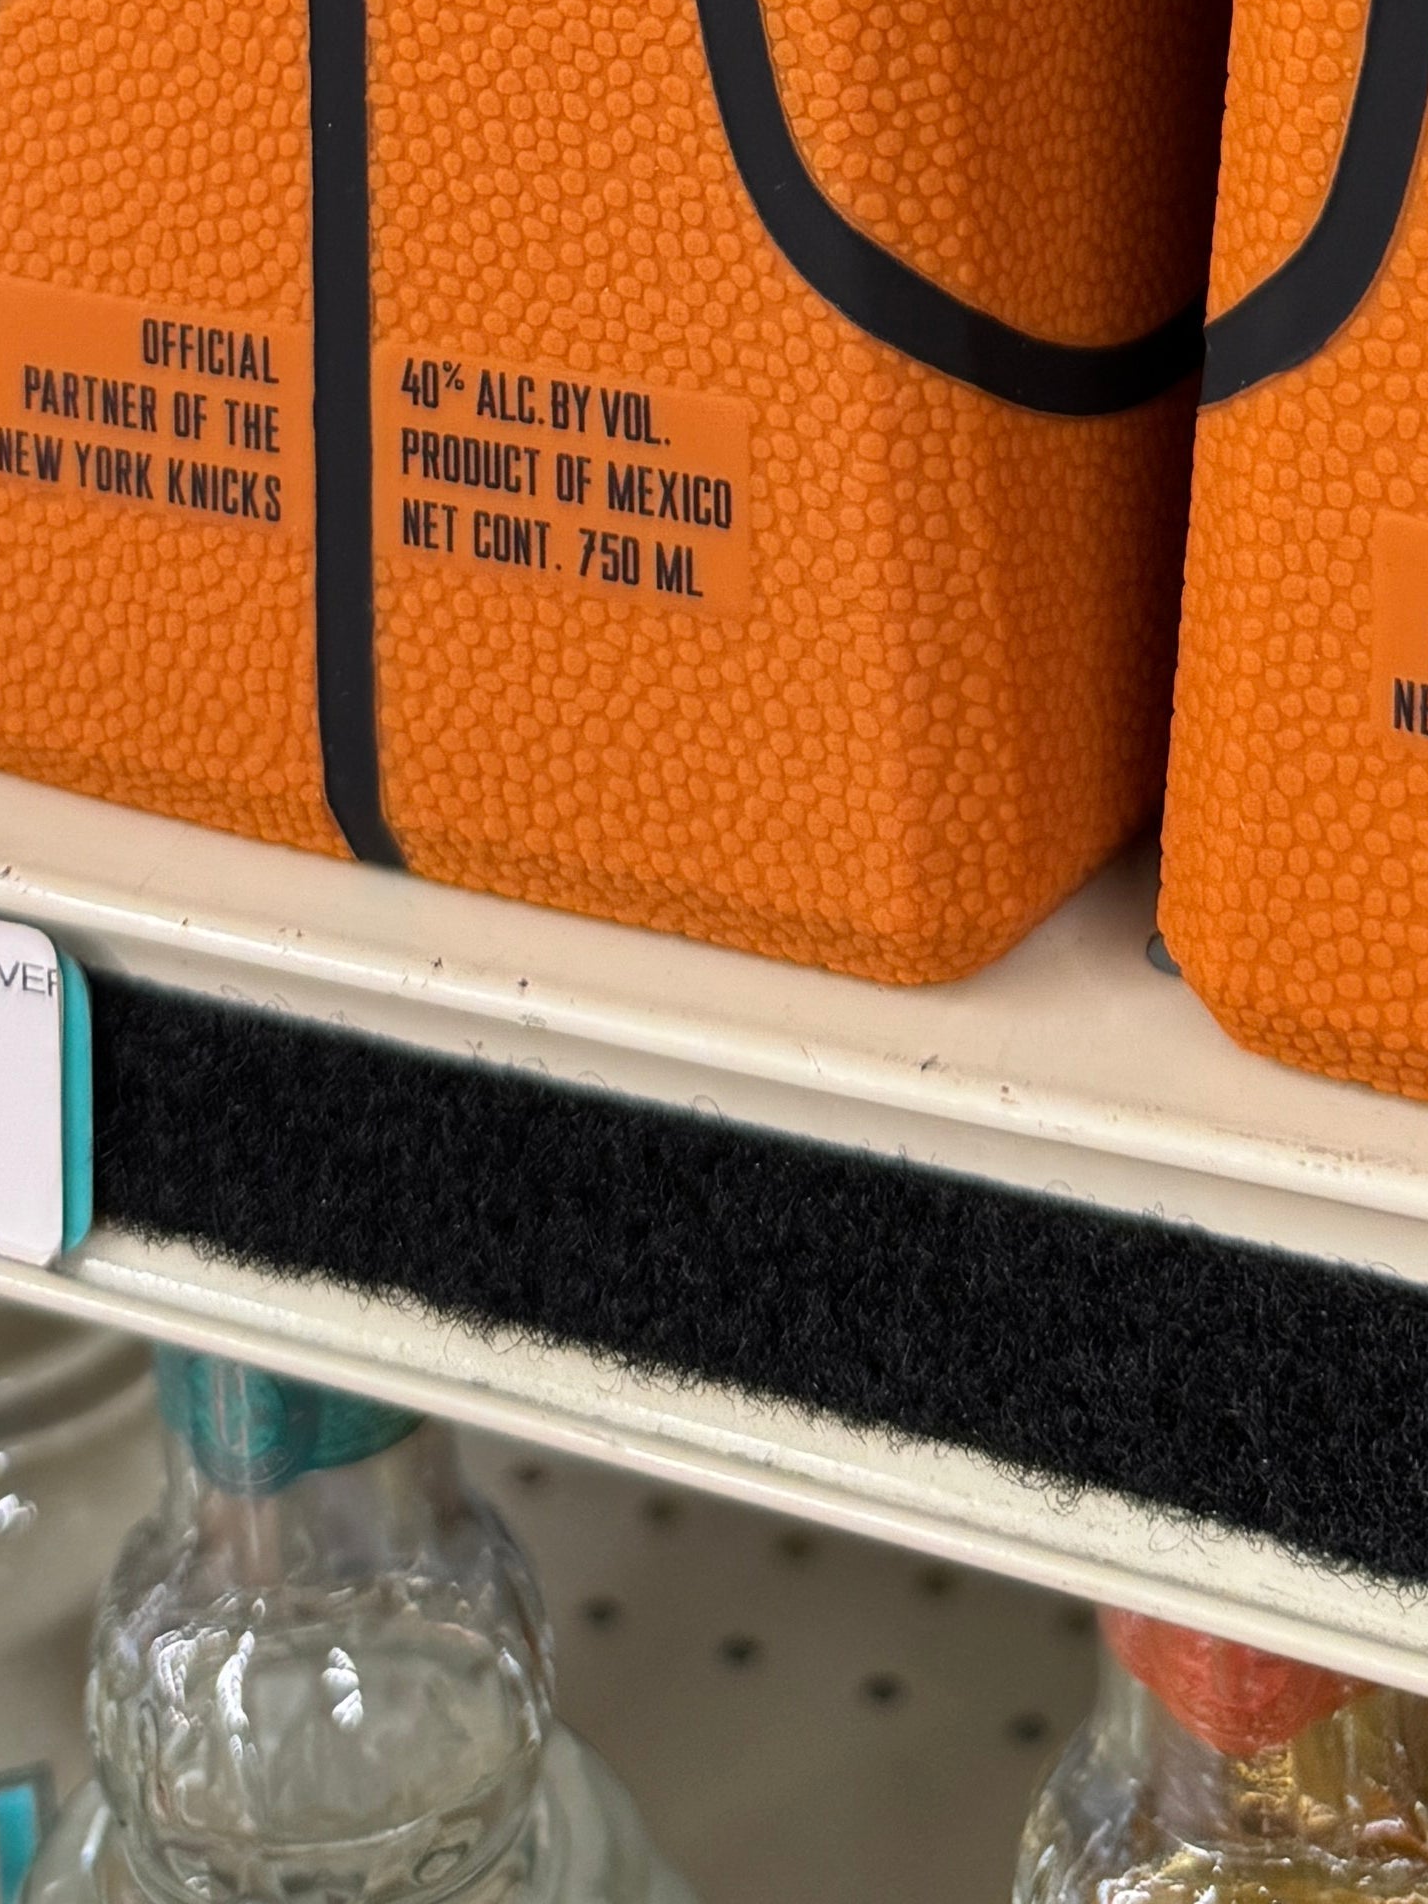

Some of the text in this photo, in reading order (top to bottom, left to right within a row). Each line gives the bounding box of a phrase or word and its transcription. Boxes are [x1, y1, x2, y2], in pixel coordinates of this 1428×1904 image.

[142, 317, 279, 384] OFFICIAL
[23, 364, 281, 454] PARTNER OF THE
[401, 358, 465, 409] 40%
[600, 392, 671, 447] VOL.
[74, 442, 153, 500] YORK
[169, 459, 282, 522] KNICKS
[401, 427, 732, 530] PRODUCT OF MEXICO
[402, 499, 458, 552] NET
[580, 527, 640, 586] 750
[655, 541, 703, 598] ML
